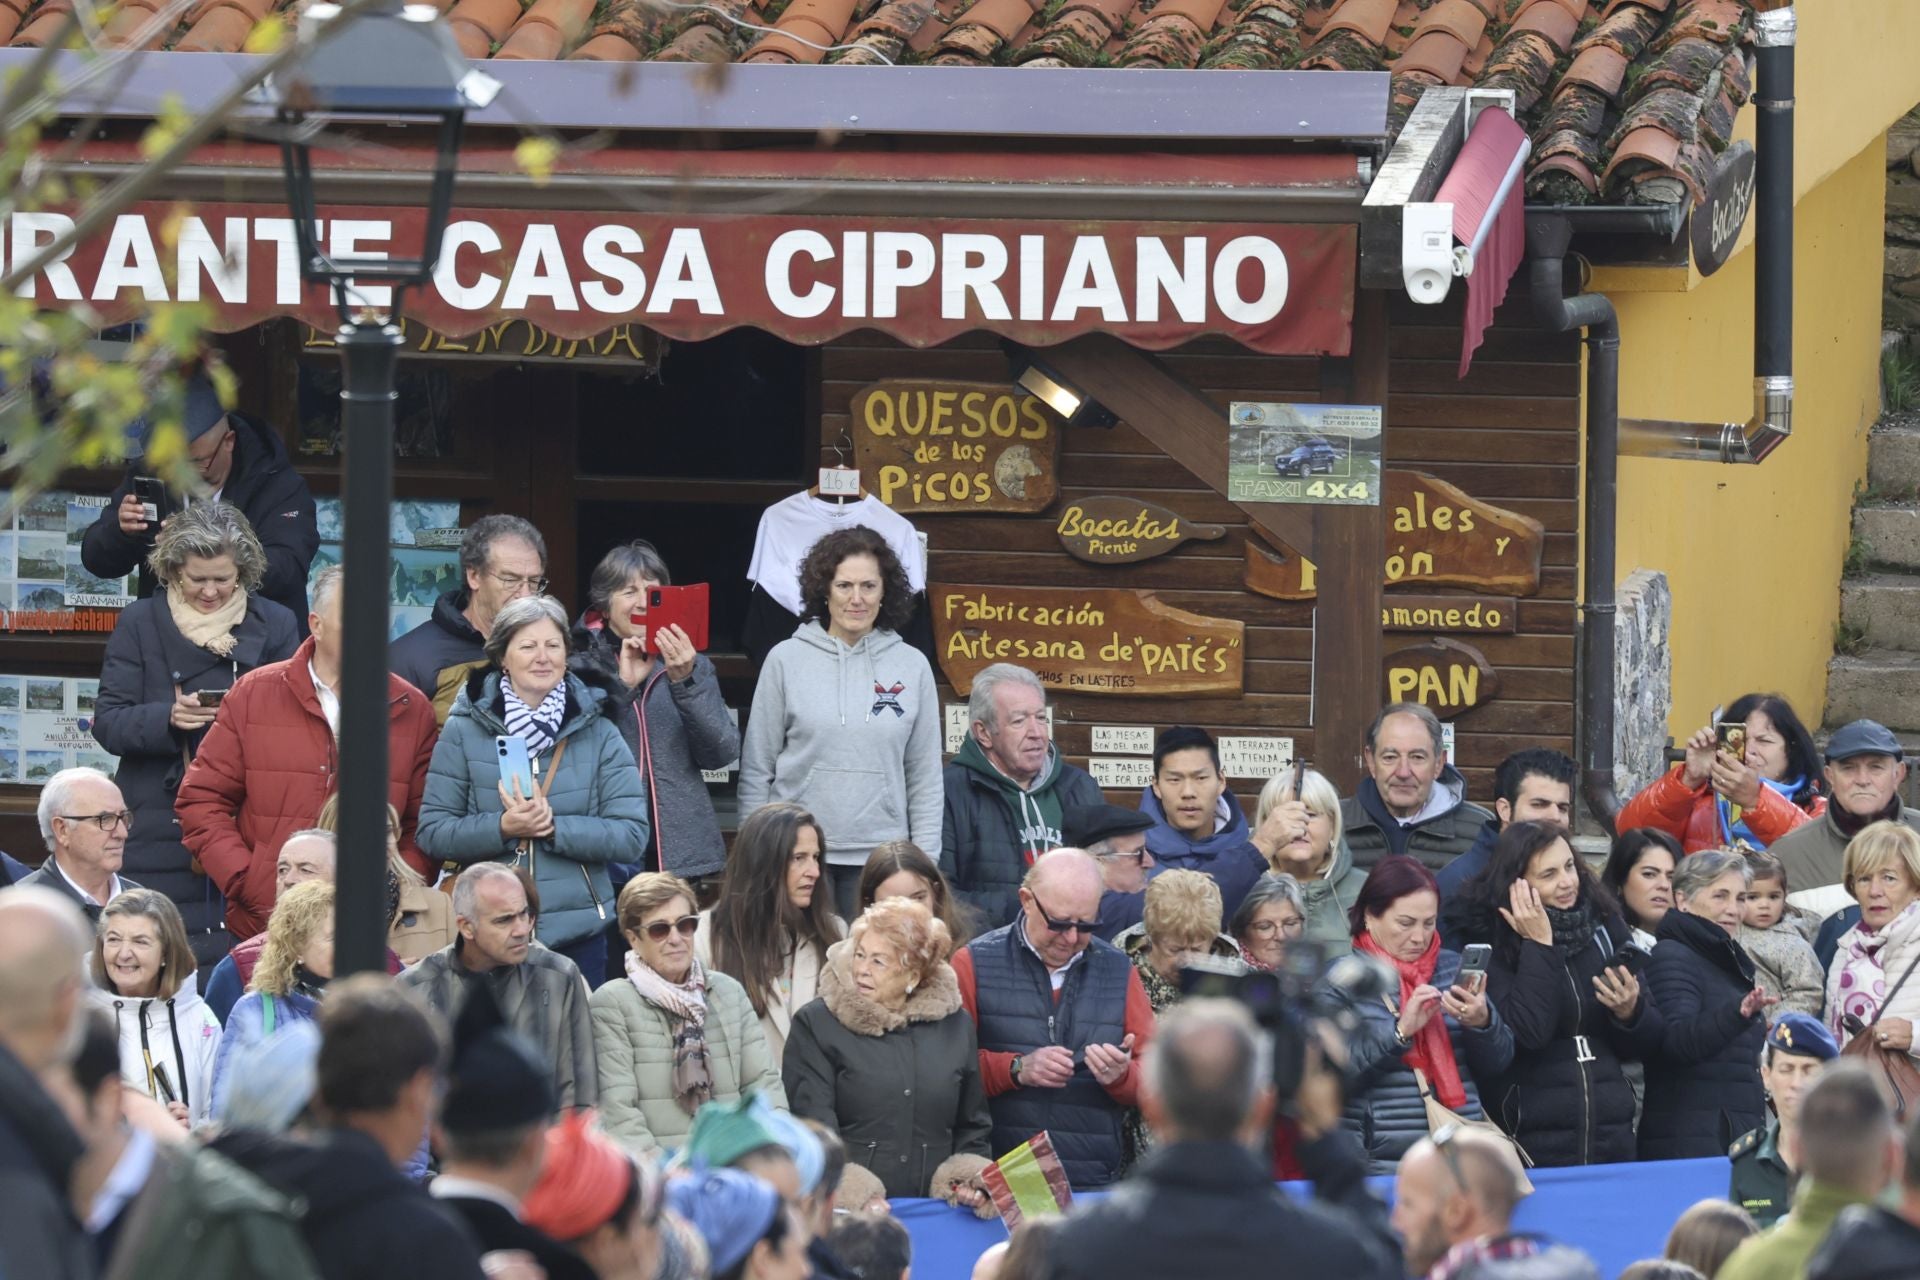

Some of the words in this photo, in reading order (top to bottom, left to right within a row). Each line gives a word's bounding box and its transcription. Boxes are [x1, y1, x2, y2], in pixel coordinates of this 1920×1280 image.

[0, 211, 392, 308] RANTE
[432, 219, 725, 316] CASA
[765, 229, 1289, 324] CIPRIANO
[864, 390, 1048, 440] QUESOS
[914, 441, 941, 463] de
[952, 440, 986, 463] los
[822, 471, 843, 490] 16
[879, 465, 992, 505] Picos
[1234, 479, 1301, 497] TAXI
[1306, 480, 1369, 499] 4x4
[1393, 491, 1475, 533] ales
[1057, 506, 1180, 540] Bocatas
[1089, 540, 1138, 555] Picnic
[1384, 545, 1434, 581] ón
[945, 593, 1105, 627] Fabricación
[947, 630, 1086, 661] Artesana
[1099, 631, 1133, 662] de
[1037, 671, 1063, 684] CHOS
[1070, 673, 1084, 686] EN
[1088, 674, 1136, 688] LASTRES
[1388, 664, 1479, 707] PAN
[1095, 730, 1111, 740] LAS
[1115, 730, 1149, 741] MESAS
[1221, 740, 1232, 750] LA
[1238, 740, 1275, 751] TERRAZA
[1277, 741, 1289, 751] DE
[1113, 742, 1129, 751] DEL
[1092, 763, 1110, 772] THE
[1115, 763, 1150, 773] TABLES
[1224, 753, 1236, 762] LA
[1240, 753, 1278, 763] TIENDA
[1233, 764, 1245, 775] LA
[1115, 775, 1132, 785] FOR
